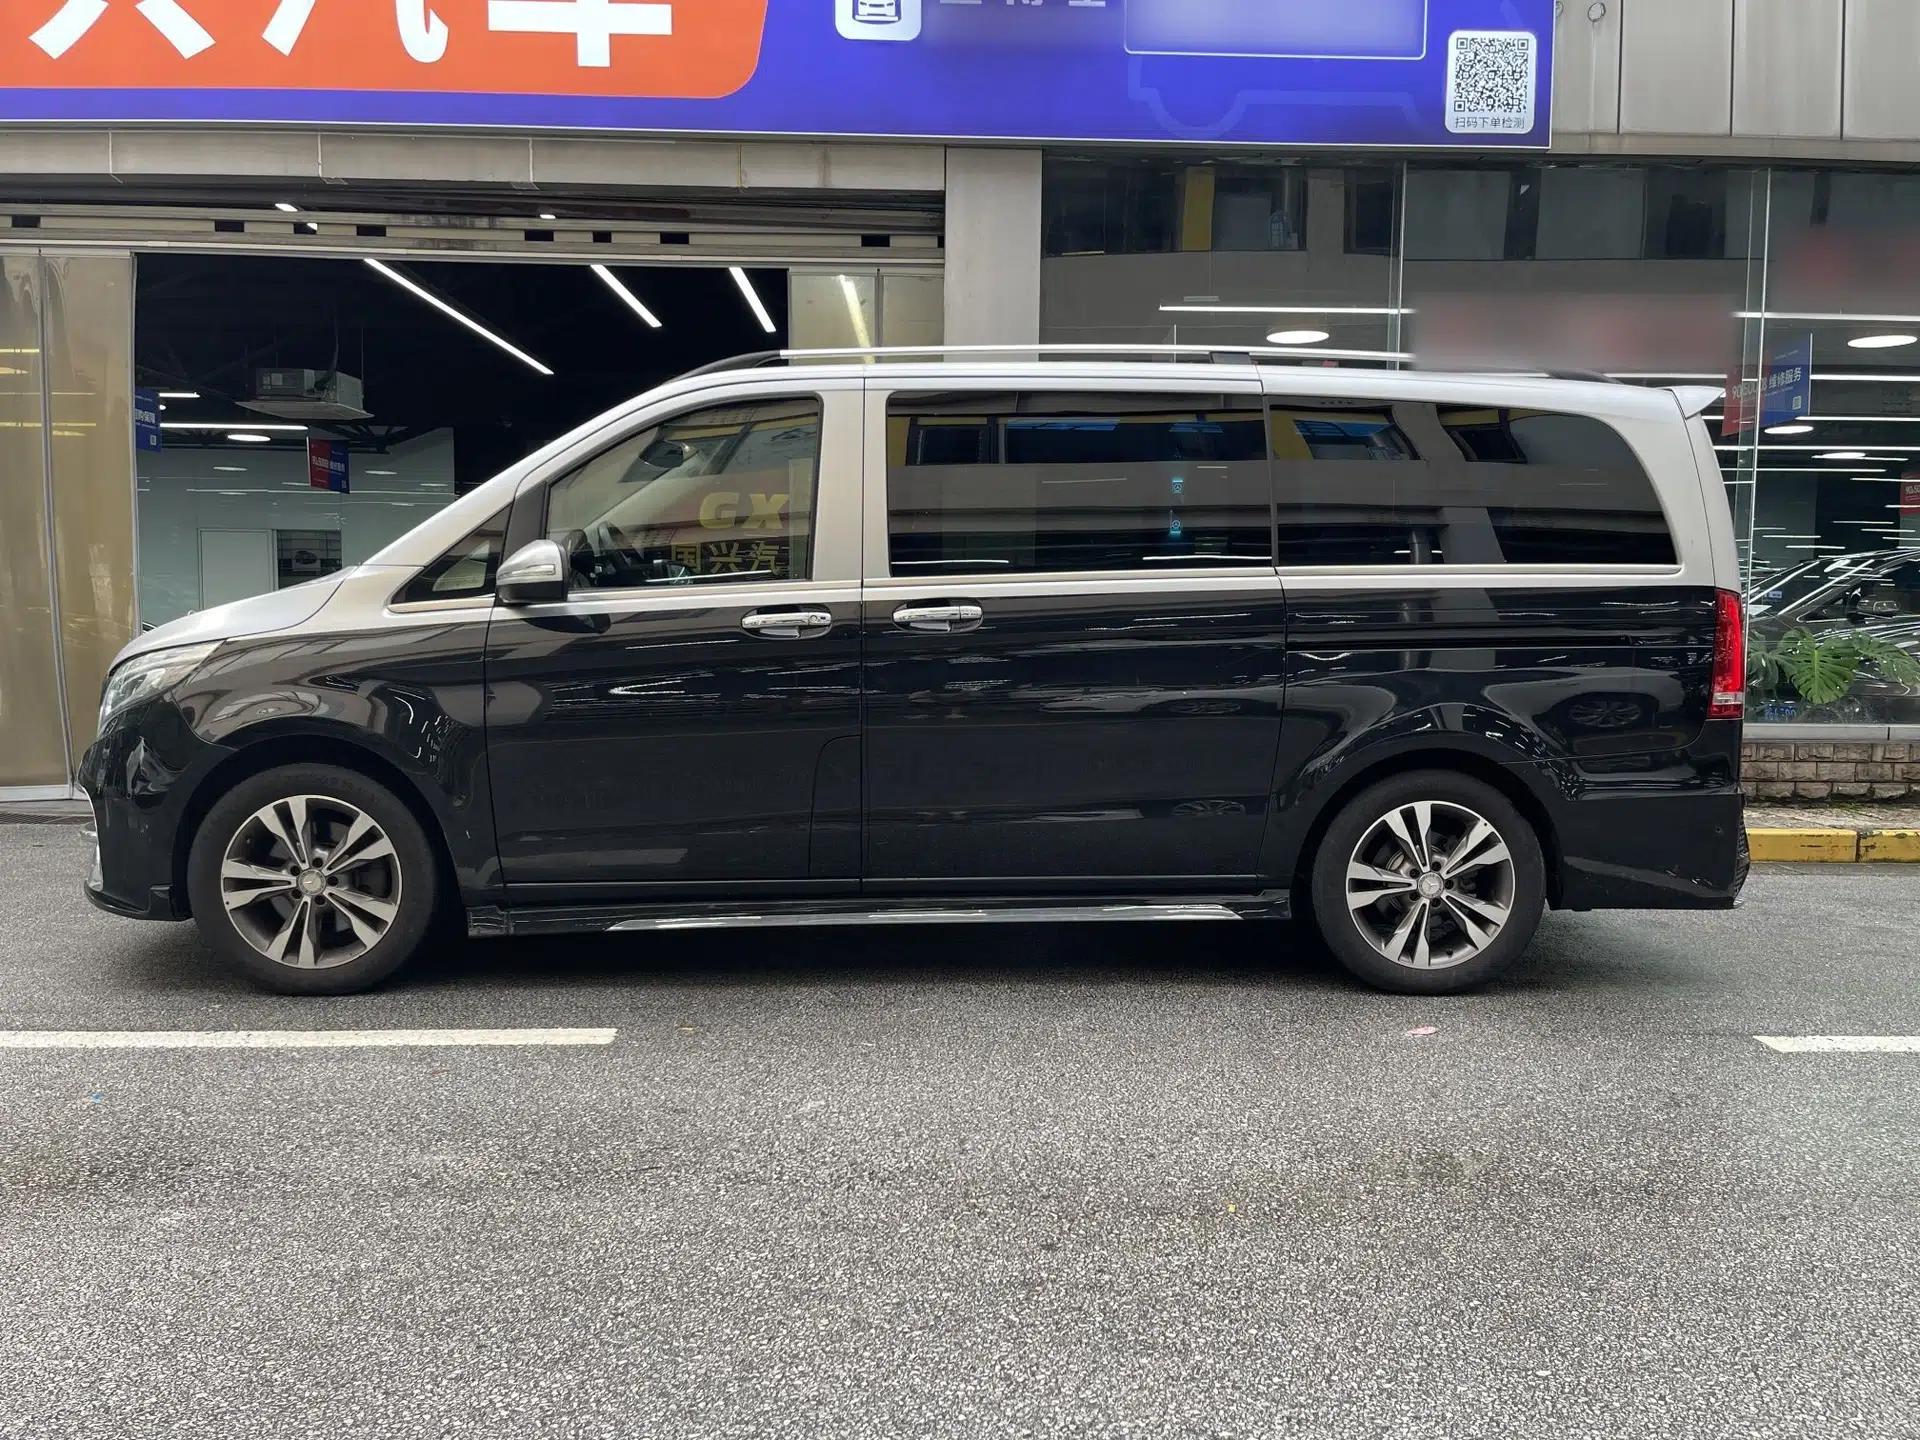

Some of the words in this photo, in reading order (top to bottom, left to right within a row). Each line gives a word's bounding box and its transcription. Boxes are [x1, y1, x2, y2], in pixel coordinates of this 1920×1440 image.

[1455, 116, 1525, 128] 扫码下单检测
[699, 492, 789, 529] GX
